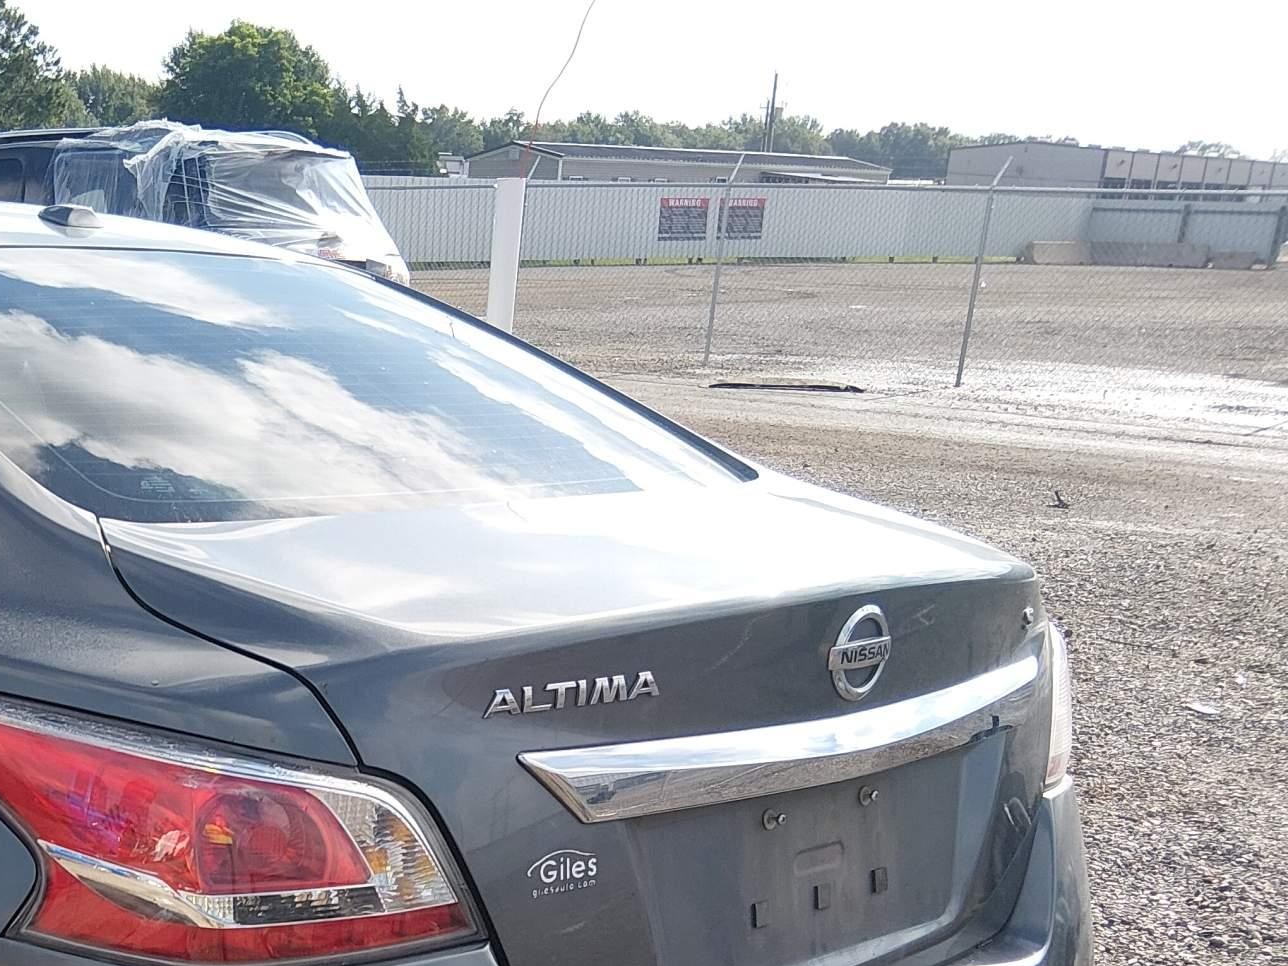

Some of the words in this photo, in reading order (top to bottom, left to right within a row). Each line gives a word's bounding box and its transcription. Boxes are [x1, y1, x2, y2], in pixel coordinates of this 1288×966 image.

[840, 642, 890, 665] NISSAN
[482, 671, 660, 719] ALTIMA
[540, 857, 597, 883] Giles
